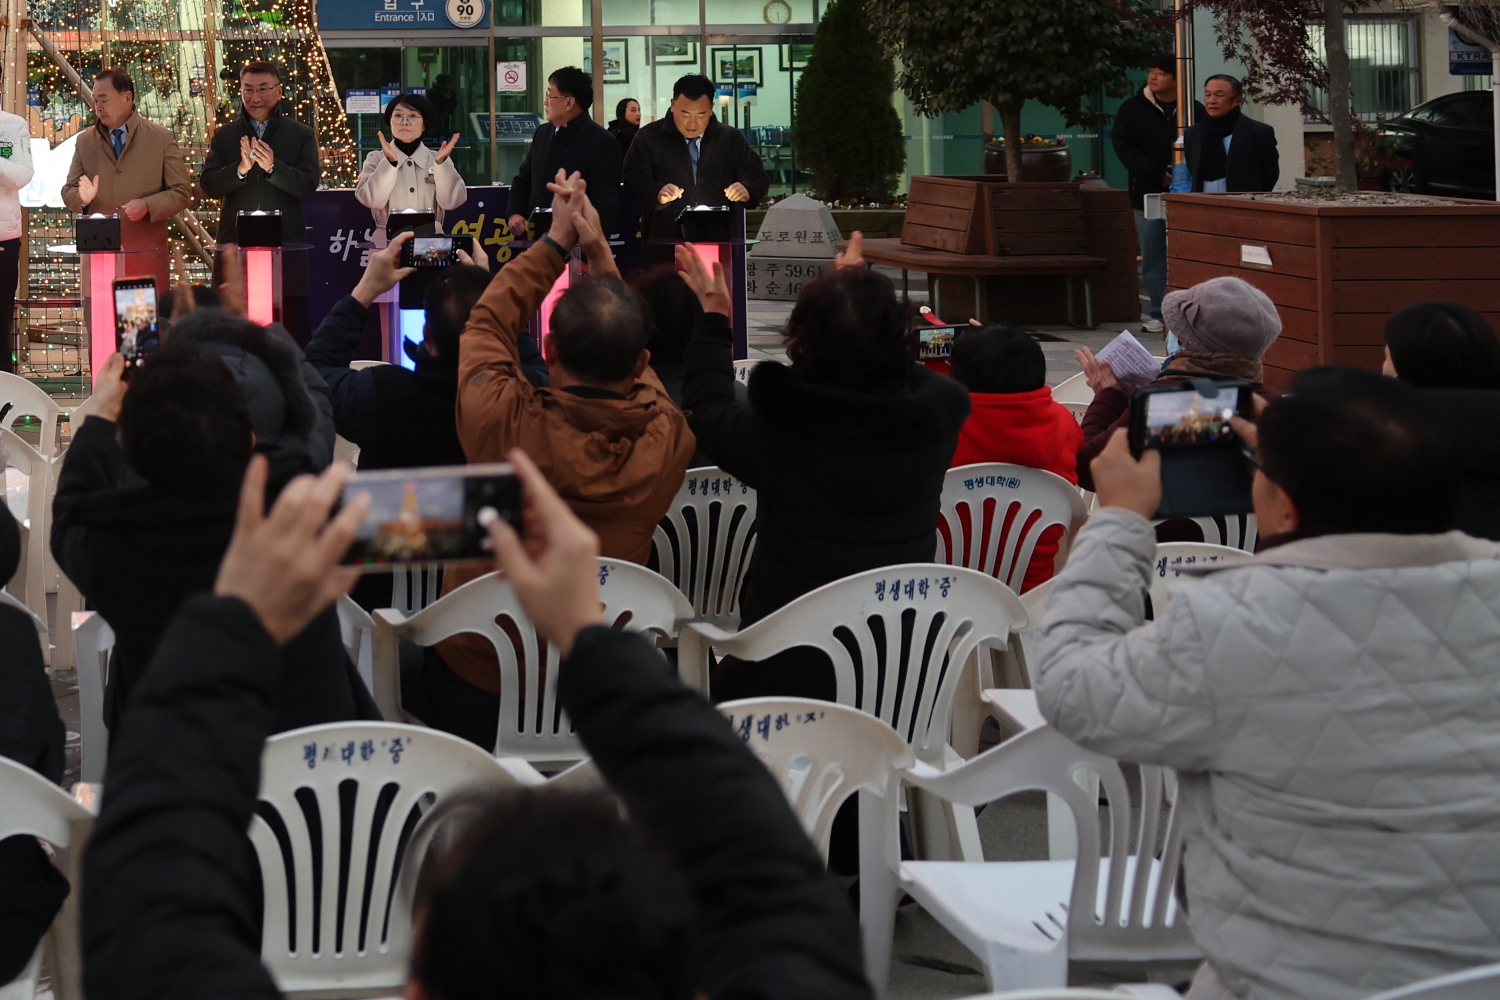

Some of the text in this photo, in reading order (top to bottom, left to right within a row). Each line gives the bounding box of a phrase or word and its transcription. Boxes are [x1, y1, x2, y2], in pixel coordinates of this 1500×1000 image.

[375, 12, 414, 22] Entrance
[457, 4, 474, 16] 90
[761, 230, 825, 244] 도로원표
[963, 475, 1021, 490] 평생대학(원)
[875, 578, 930, 601] 평생대학
